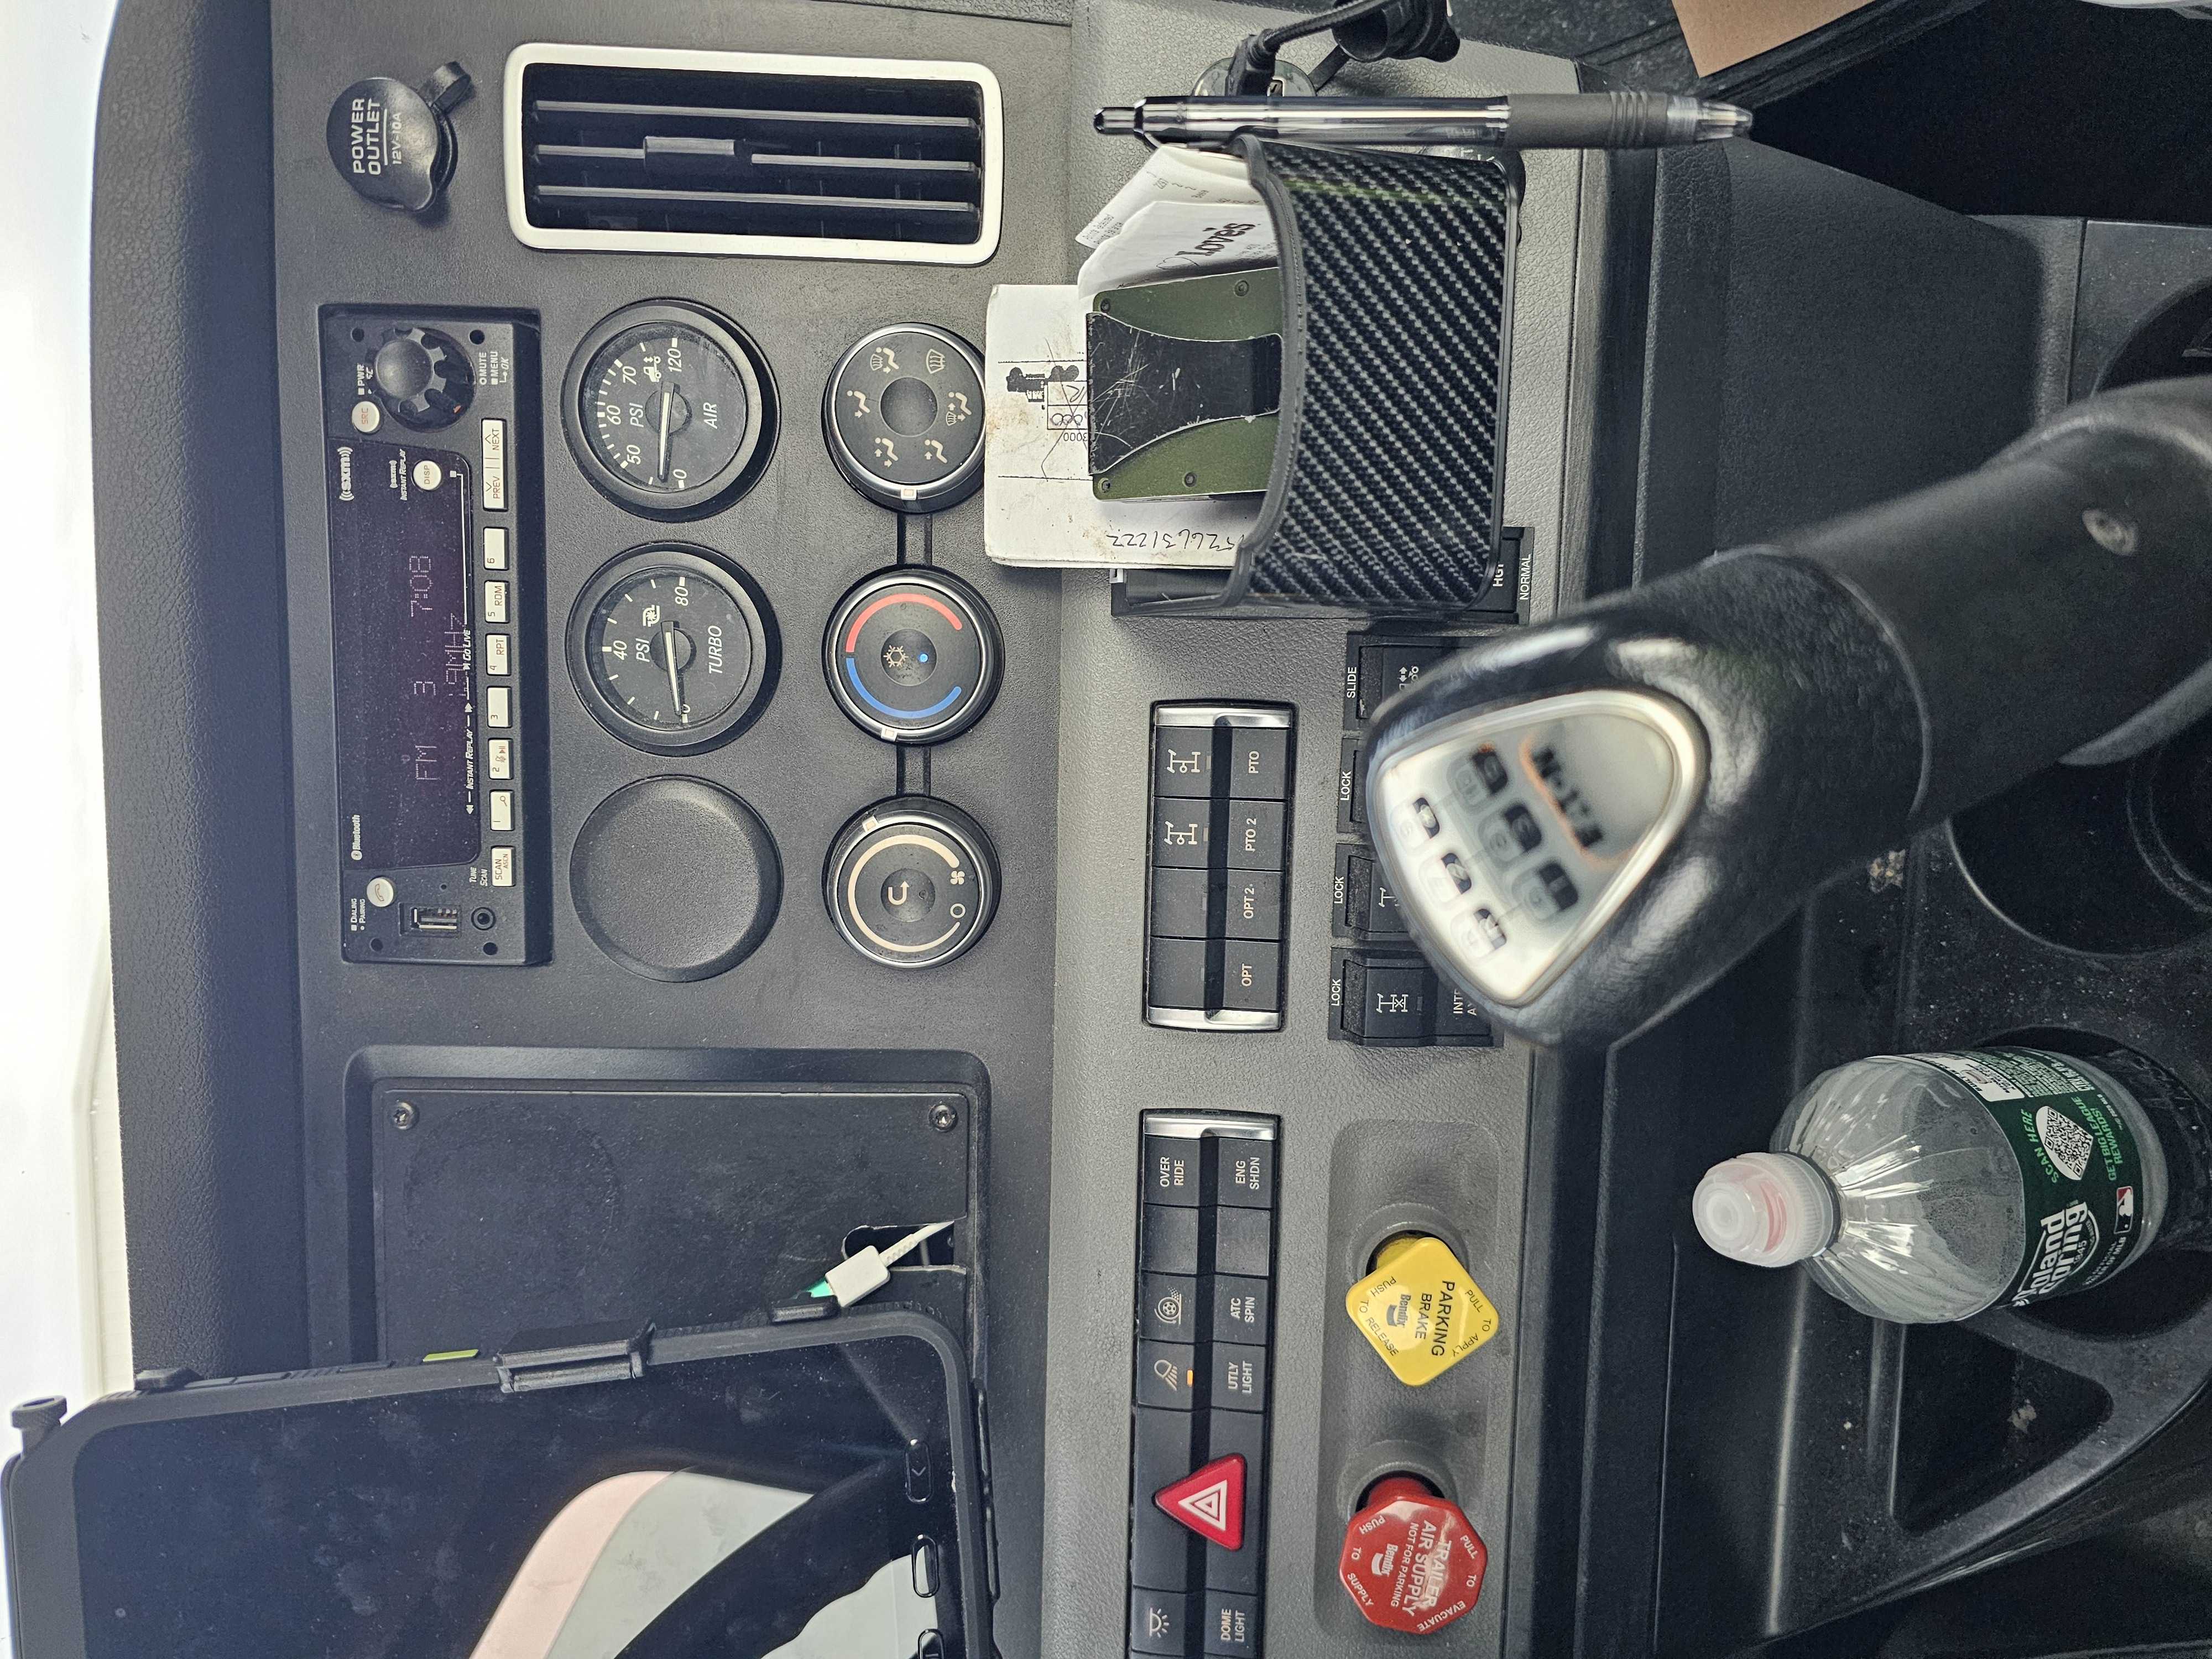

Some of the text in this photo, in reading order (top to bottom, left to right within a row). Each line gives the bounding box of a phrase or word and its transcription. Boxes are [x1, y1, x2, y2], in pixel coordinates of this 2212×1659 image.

[351, 98, 366, 174] POWER
[367, 97, 381, 175] OUTLET
[391, 112, 403, 165] 12V-10A
[479, 352, 487, 377] MUTE
[490, 350, 498, 377] MENU
[501, 357, 509, 370] OK
[667, 347, 682, 373] 120
[357, 364, 365, 386] PWR
[622, 366, 638, 386] 70
[606, 404, 622, 426] 60
[629, 402, 645, 428] PSI
[703, 401, 718, 429] AIR
[492, 428, 500, 451] NEXT
[399, 448, 407, 475] REPLAY
[625, 444, 643, 466] 50
[492, 476, 501, 499] PREV
[672, 468, 688, 480] 0
[409, 555, 434, 617] 7:08
[1519, 554, 1531, 601] NORMAL
[494, 585, 503, 606] RDM
[674, 586, 690, 607] 80
[495, 639, 505, 656] RPT
[612, 639, 629, 660] 40
[635, 639, 651, 662] PSI
[707, 625, 724, 675] TURBO
[1347, 666, 1358, 698] SLIDE
[414, 745, 437, 780] FM
[465, 729, 474, 790] INSTANT REPLAY
[1248, 750, 1260, 774] PTO
[1340, 771, 1352, 801] LOCK
[352, 815, 361, 850] Bluetooth
[1244, 828, 1256, 851] PTO
[1334, 876, 1345, 904] LOCK
[1243, 896, 1254, 919] OPT
[1241, 963, 1253, 987] OPT
[1331, 978, 1342, 1006] LOCK
[2021, 1108, 2059, 1183] SCAN HERE
[2070, 1096, 2117, 1181] GET BIG LEAGUE
[2089, 1107, 2124, 1164] REWARDS!
[1160, 1157, 1171, 1187] OVER
[1173, 1159, 1185, 1186] RIDE
[1234, 1160, 1246, 1184] ENG
[1249, 1156, 1261, 1190] SHDN
[1230, 1297, 1242, 1319] ATC
[1243, 1296, 1255, 1323] SPIN
[1359, 1275, 1399, 1357] PUSH TO RELEASE
[1396, 1293, 1412, 1327] Bendix
[1415, 1292, 1432, 1339] BRAKE
[1431, 1280, 1455, 1357] PARKING
[1451, 1289, 1491, 1358] PULL TO APPLY
[1227, 1361, 1239, 1390] UTLY
[1241, 1360, 1254, 1394] LIGHT
[1347, 1515, 1386, 1606] PUSH TO SUPPLY
[1381, 1543, 1399, 1577] Bendix
[1390, 1522, 1419, 1608] NOT FOR PARKING
[1402, 1520, 1437, 1616] AIR SUPPLY
[1422, 1540, 1452, 1607] TRAILER
[1416, 1535, 1479, 1632] PULL TO EVACUATE
[1220, 1609, 1232, 1641] DOME
[1234, 1610, 1245, 1642] LIGHT
